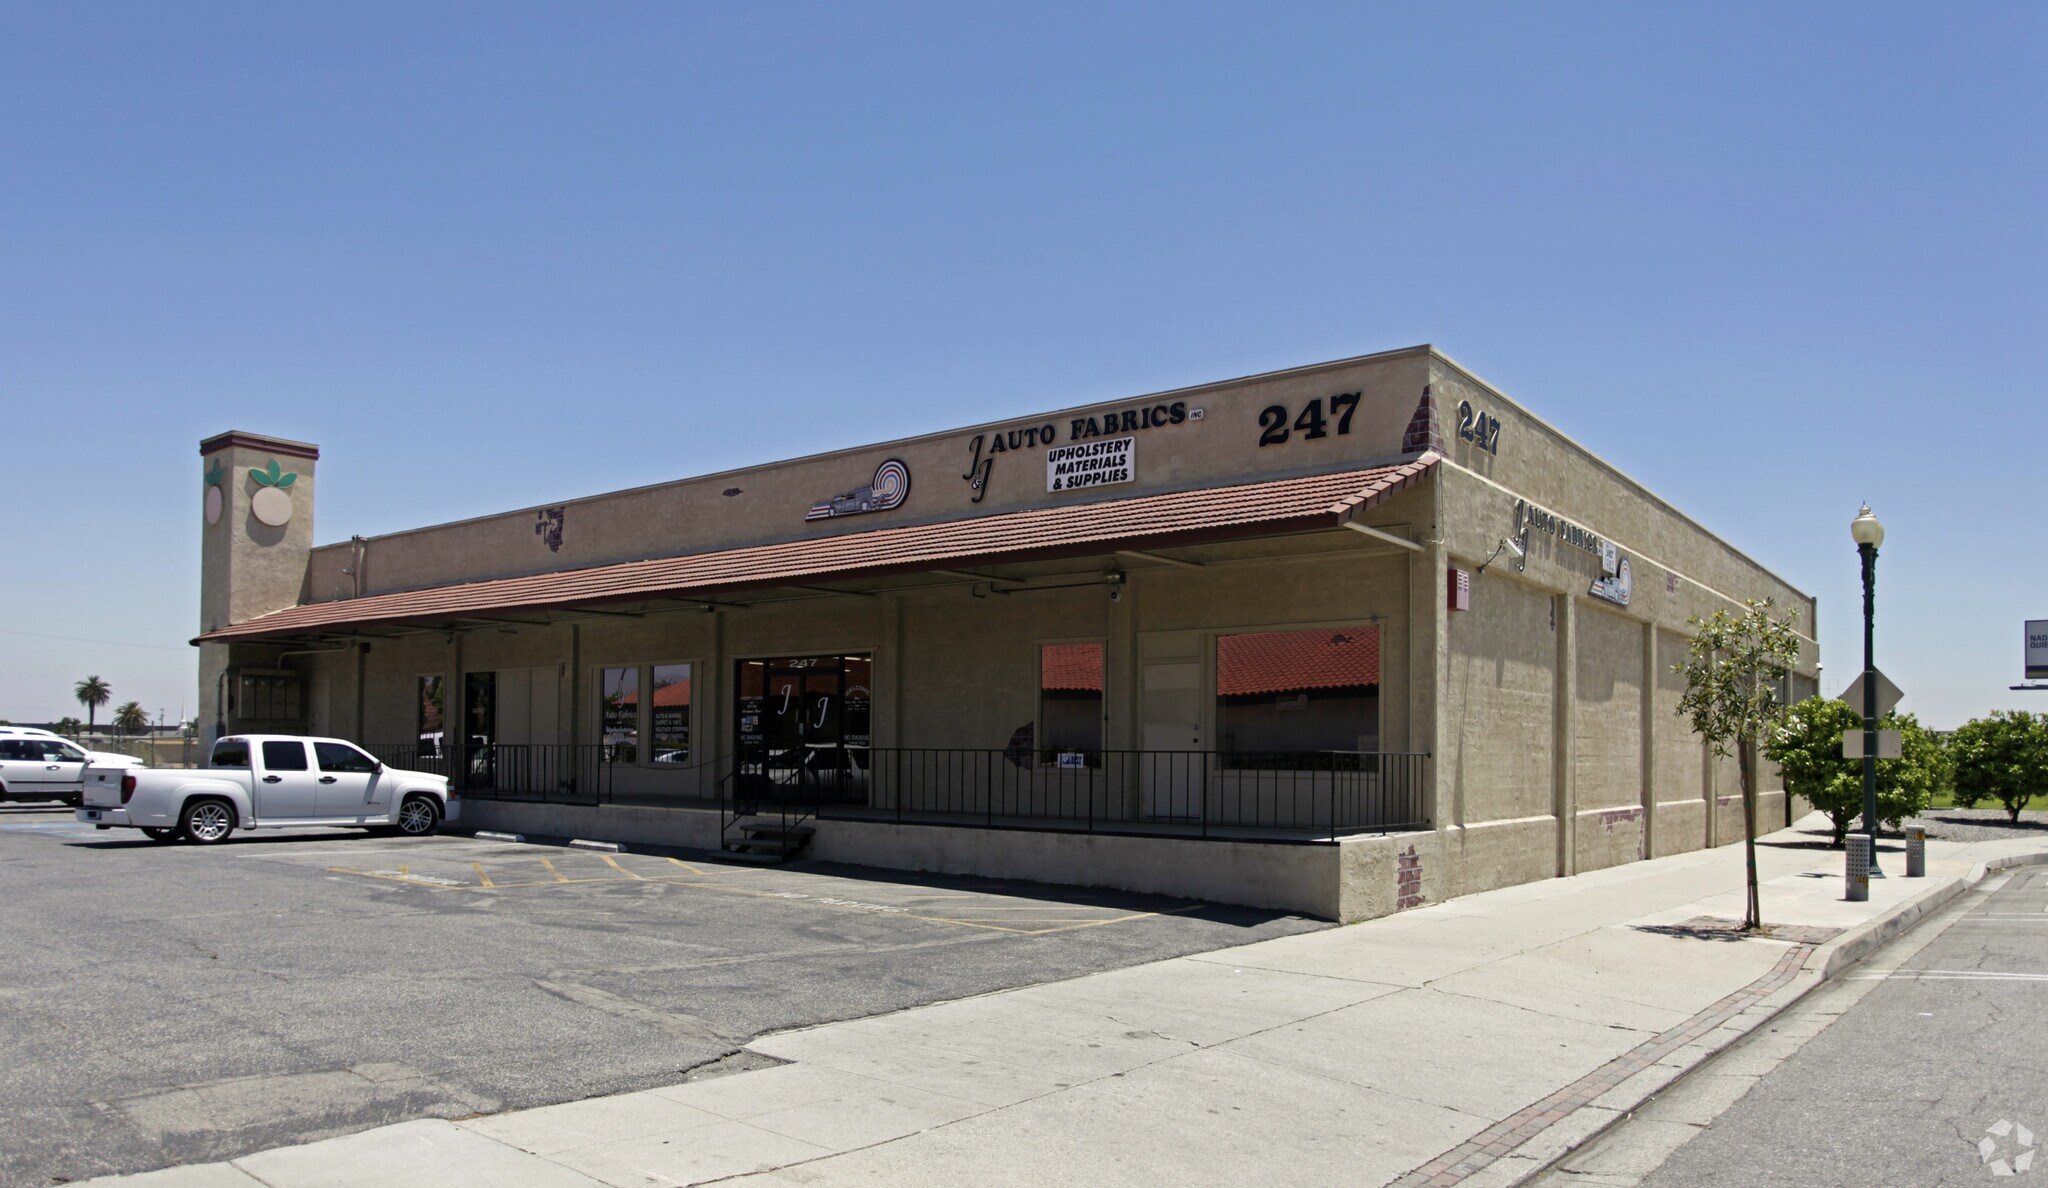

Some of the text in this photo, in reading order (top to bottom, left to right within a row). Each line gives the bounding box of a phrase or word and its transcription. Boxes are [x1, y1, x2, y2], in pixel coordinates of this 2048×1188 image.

[989, 401, 1203, 454] AUTO FABRICS INC
[1258, 391, 1362, 447] 247
[1457, 399, 1501, 456] 247
[1048, 438, 1133, 463] UPHOLSTERY
[1055, 453, 1127, 476] MATERIALS
[1052, 468, 1128, 491] & SUPPLIES
[1525, 504, 1599, 555] AUTO FABRICS
[789, 658, 818, 668] 247
[777, 684, 792, 716] J
[813, 696, 829, 729] J
